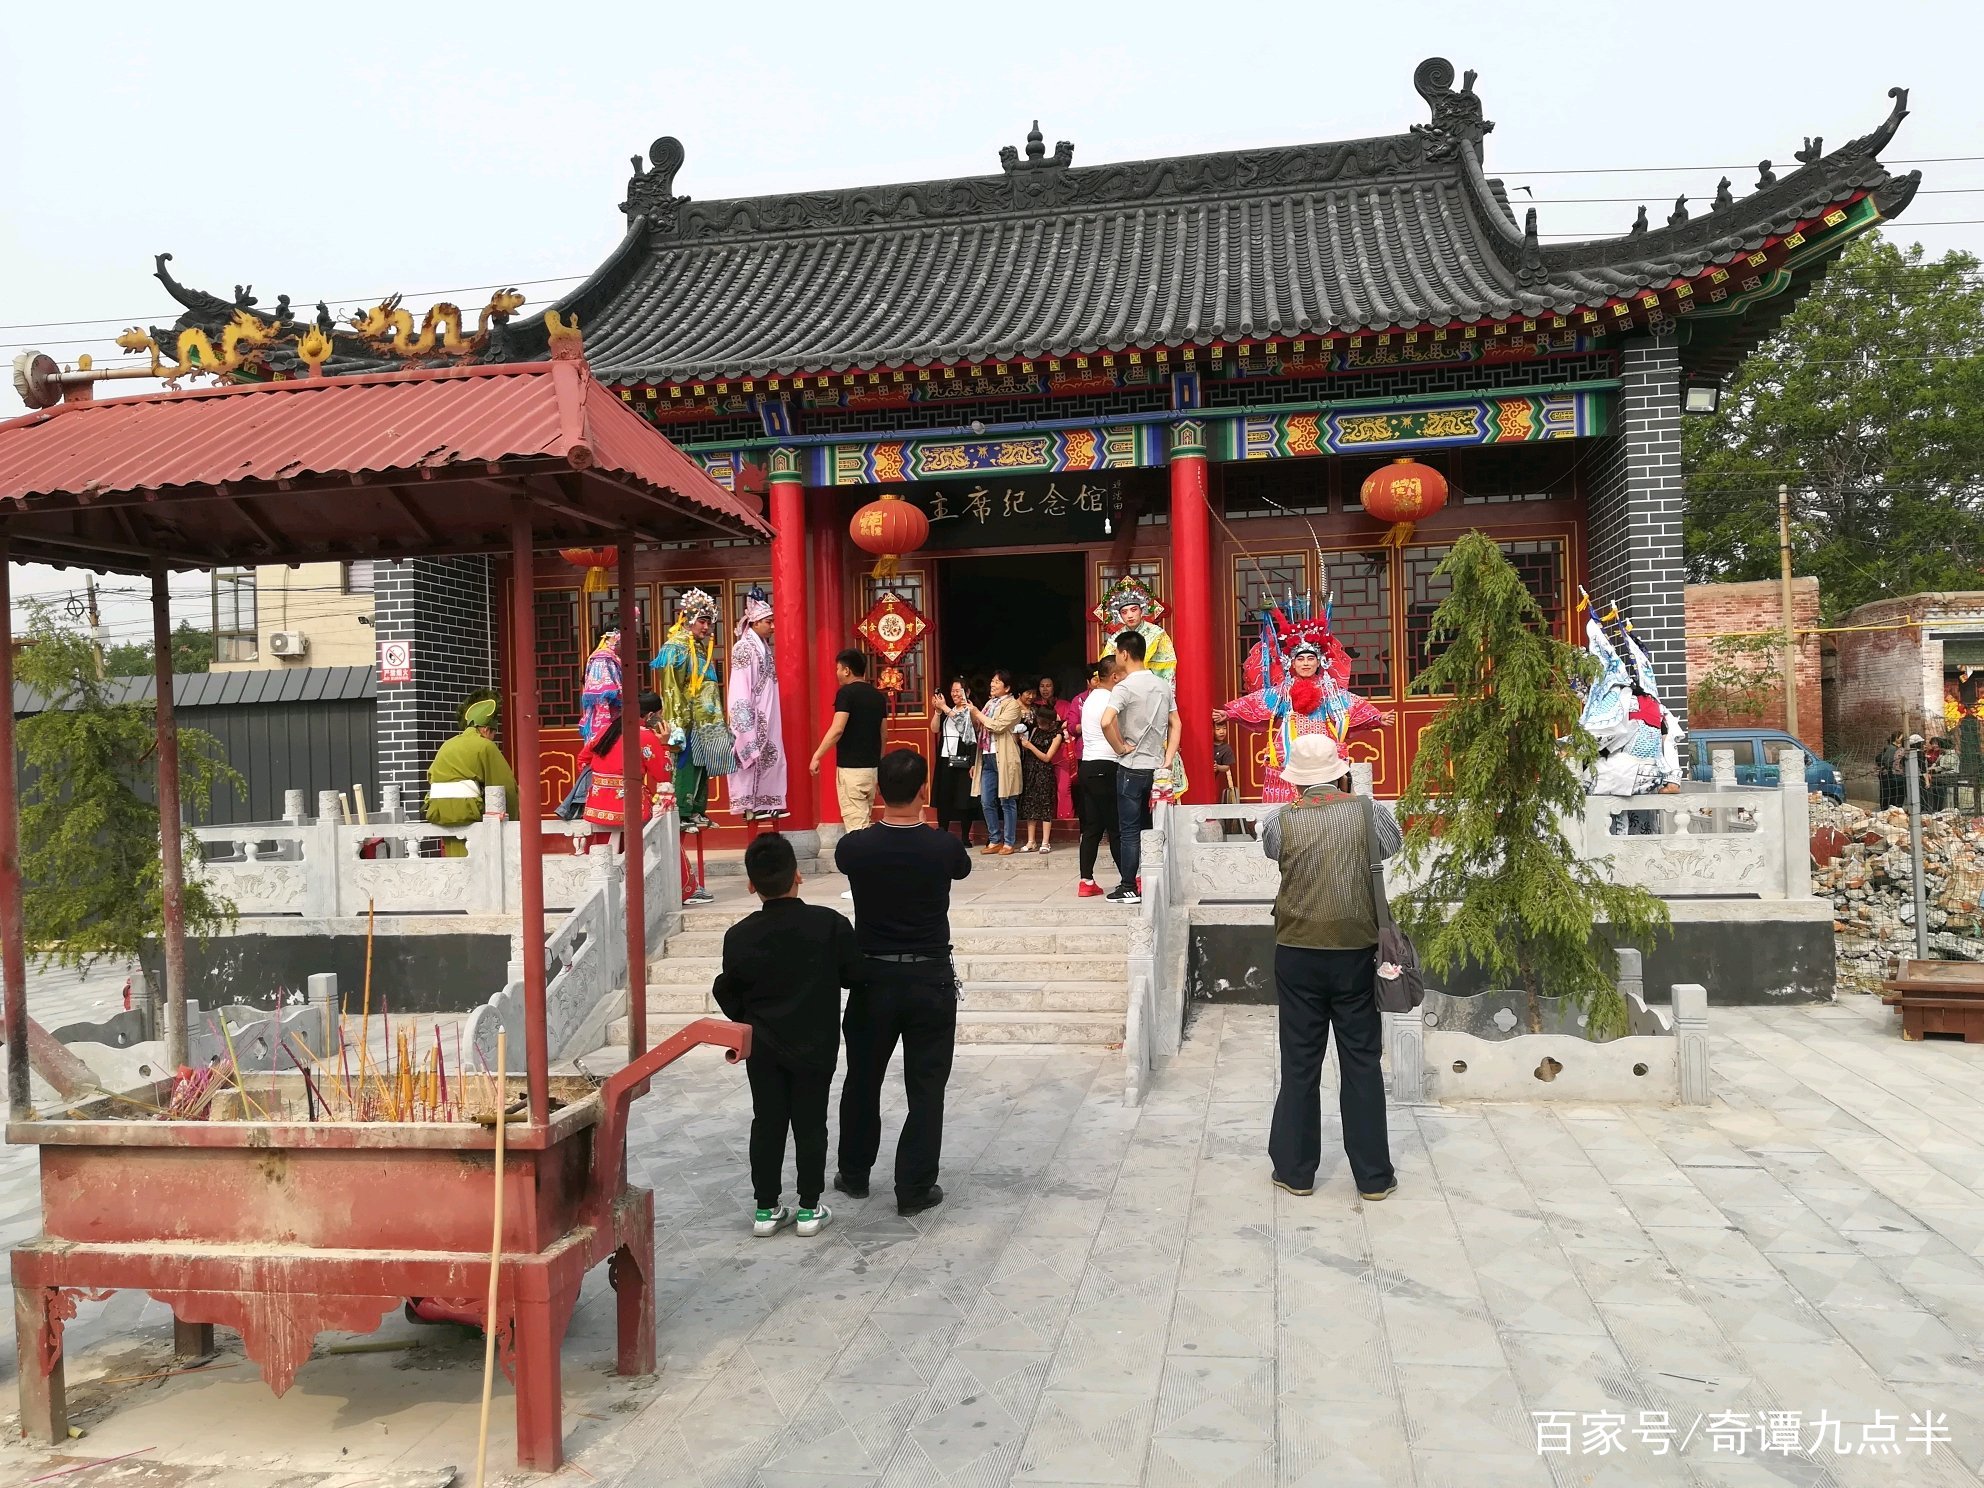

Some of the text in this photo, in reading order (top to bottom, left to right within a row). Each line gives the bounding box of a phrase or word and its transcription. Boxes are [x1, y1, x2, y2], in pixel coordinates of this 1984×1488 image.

[899, 483, 1107, 525] 主席纪念馆
